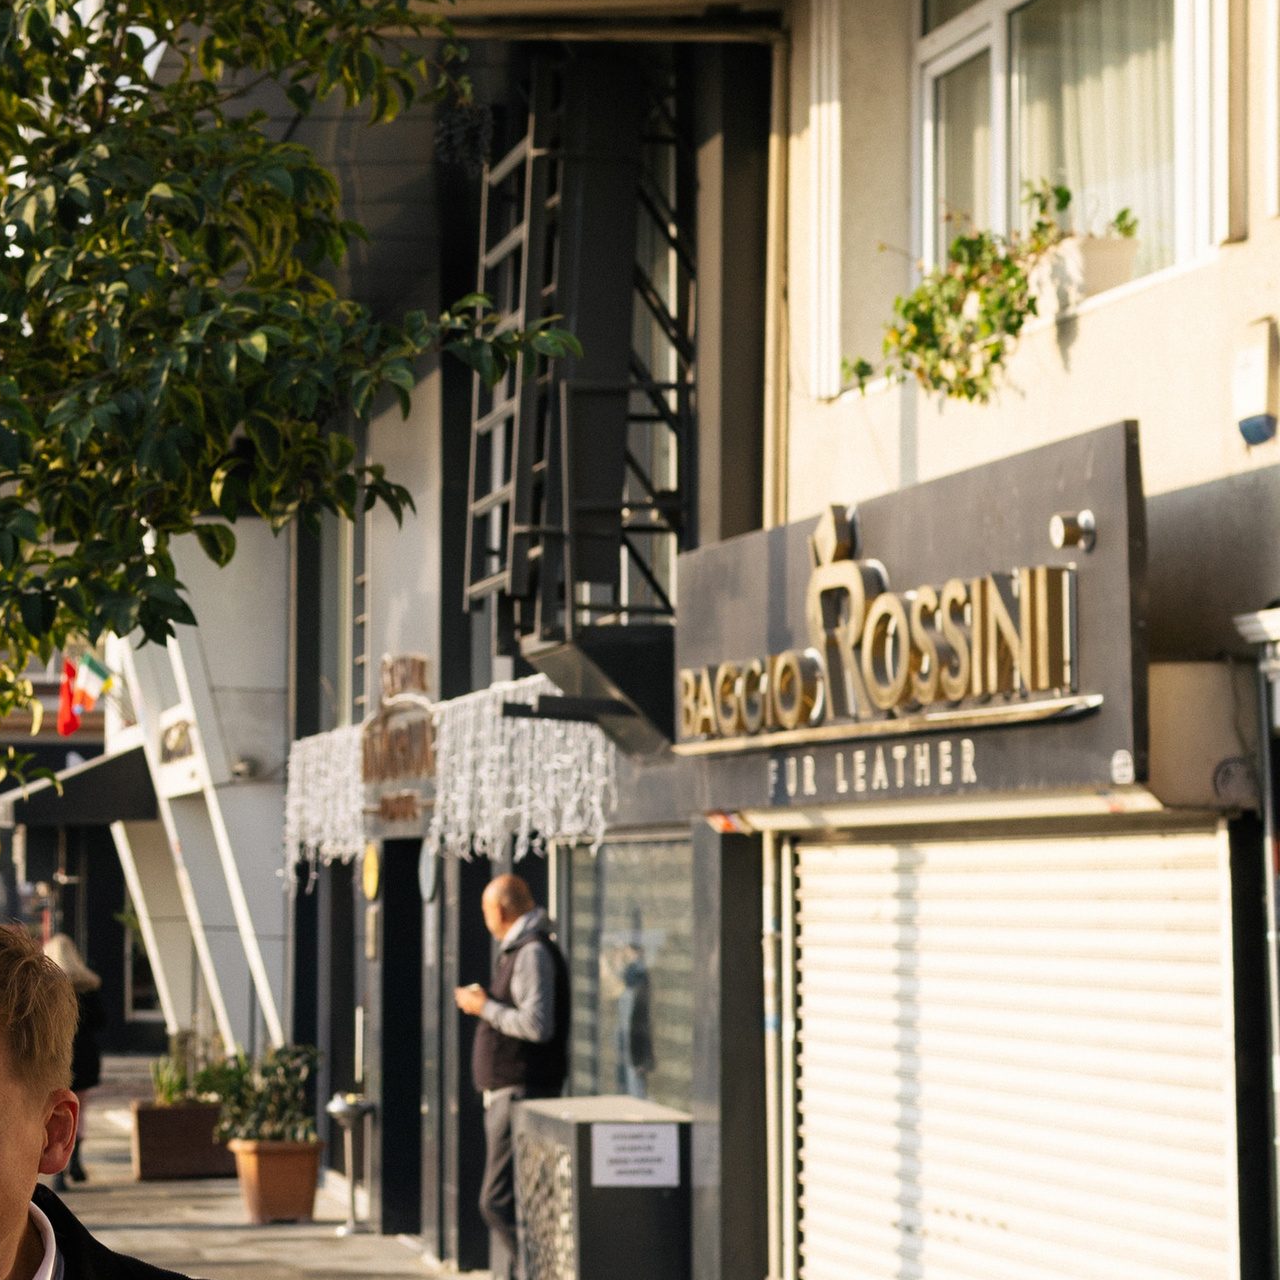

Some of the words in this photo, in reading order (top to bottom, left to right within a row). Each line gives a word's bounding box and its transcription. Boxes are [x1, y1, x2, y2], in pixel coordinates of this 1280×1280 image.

[678, 649, 818, 738] BAGGIO
[807, 558, 1065, 720] ROSSINI
[769, 755, 818, 799] FUR
[835, 738, 978, 794] LEATHER
